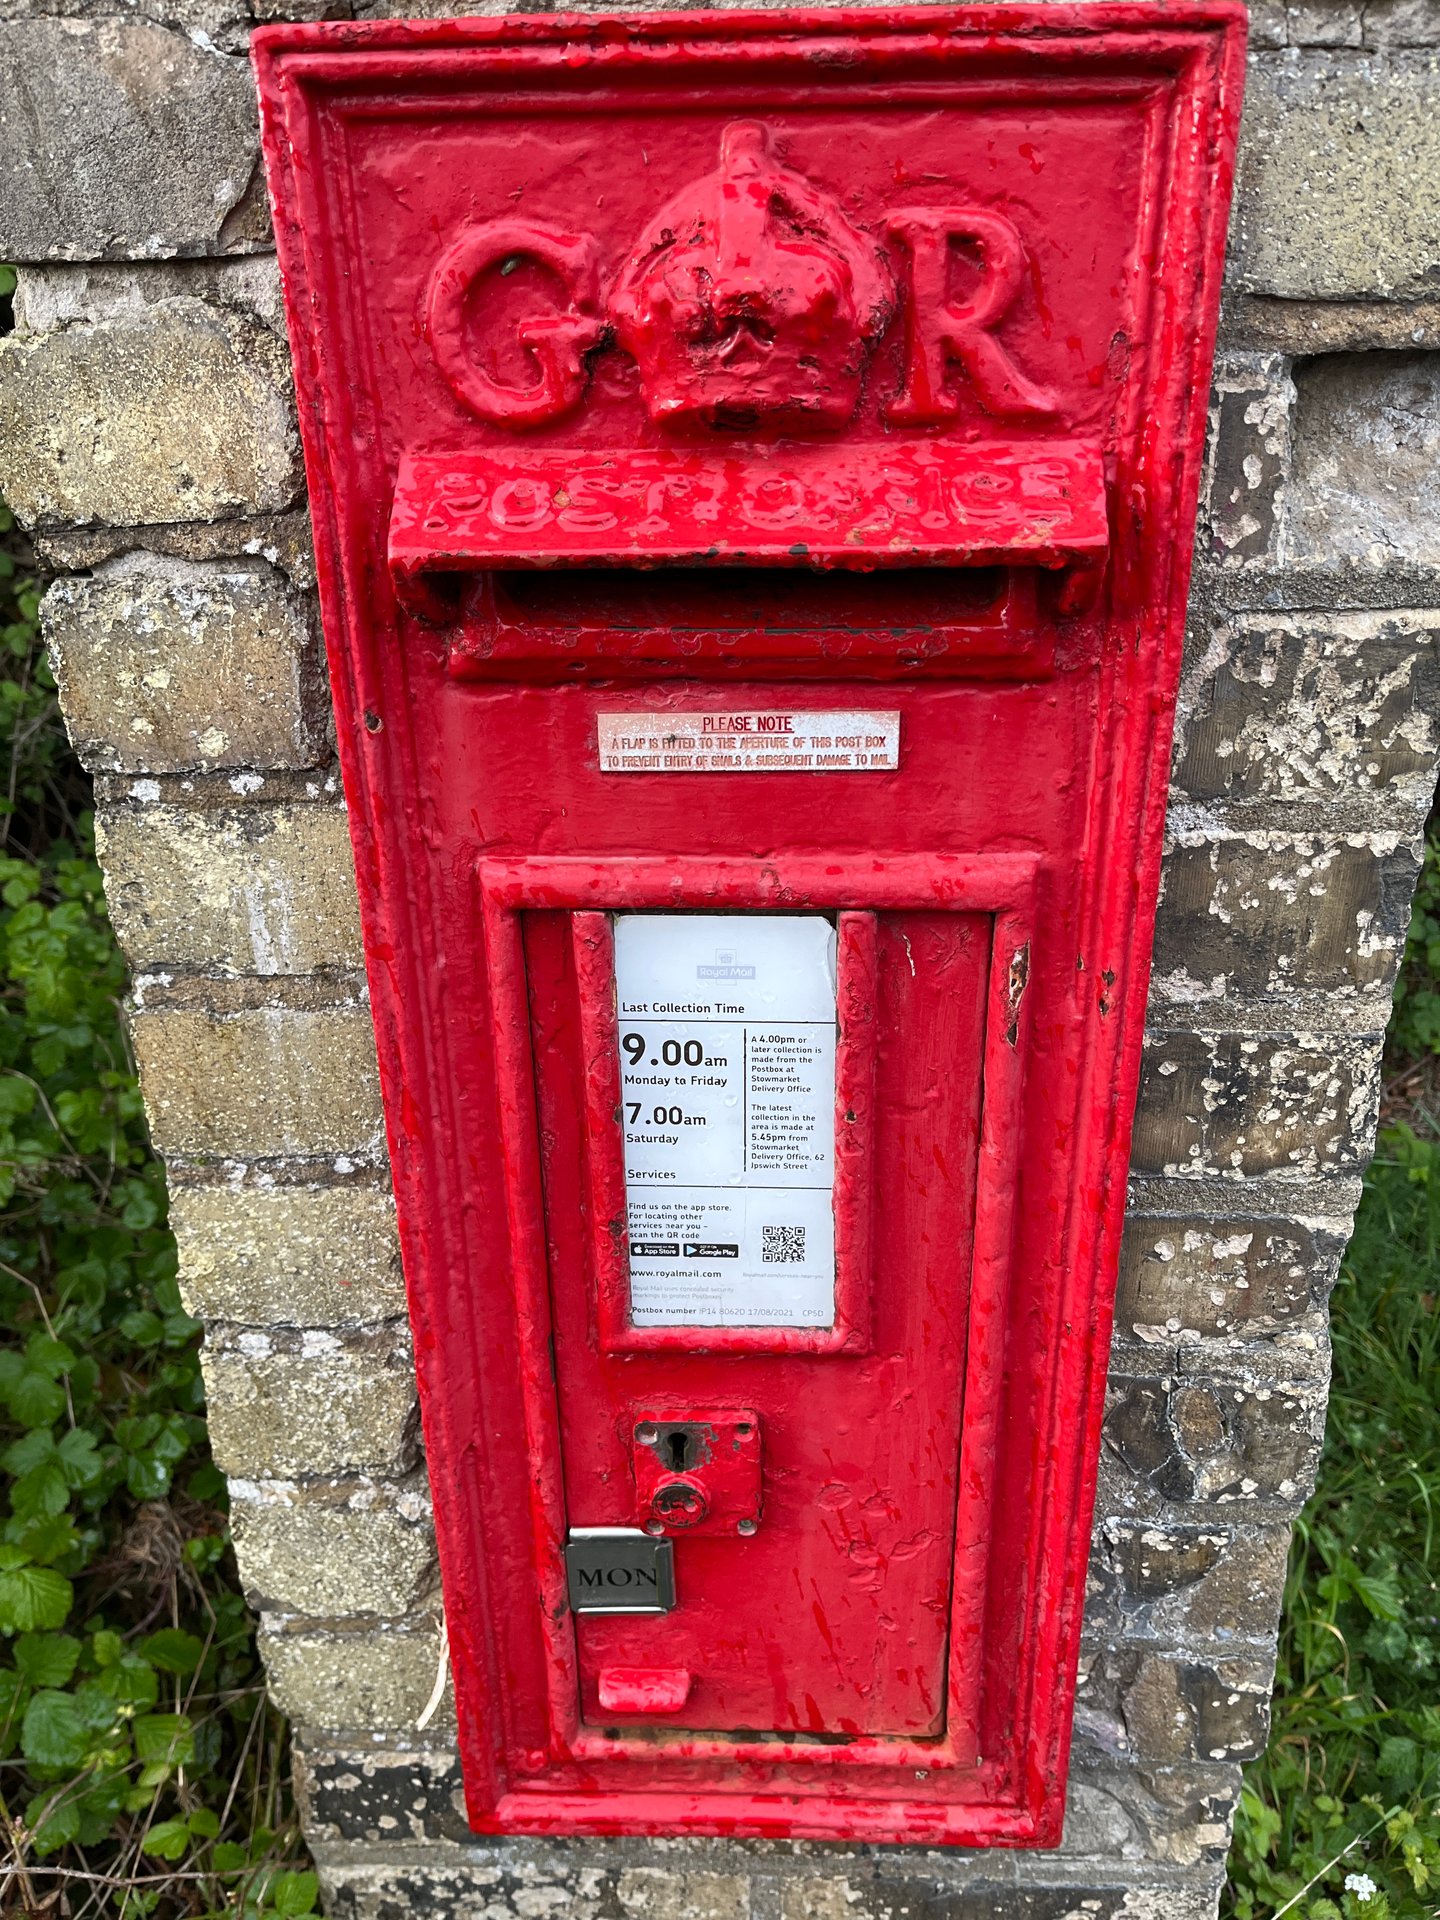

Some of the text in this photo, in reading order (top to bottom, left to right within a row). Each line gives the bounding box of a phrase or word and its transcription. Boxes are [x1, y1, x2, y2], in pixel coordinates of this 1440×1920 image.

[427, 204, 1059, 430] G R
[702, 716, 793, 732] PLEASE NOTE
[611, 735, 887, 750] A FLAP IS FITTED TO THE APERTURE OF THIS POST BOX
[606, 755, 619, 768] TO
[622, 755, 660, 768] PREVENT
[664, 755, 693, 768] ENTRY
[696, 755, 709, 768] OF
[711, 755, 742, 768] SNAILS
[756, 754, 813, 768] SUBSEQUENT
[816, 754, 852, 766] DAMAGE
[855, 753, 868, 766] TO
[870, 753, 892, 766] MAIL
[700, 967, 753, 977] Royal Mail
[622, 1002, 745, 1014] Last Collection Time
[759, 1034, 795, 1045] 4.00pm
[622, 1033, 728, 1067] 9.00am
[773, 1046, 812, 1054] collection
[751, 1065, 784, 1073] Postbox
[624, 1075, 728, 1088] Monday to Friday
[751, 1075, 801, 1083] Stowmarket
[751, 1085, 812, 1094] Delivery Office
[625, 1102, 707, 1126] 7.00am
[626, 1133, 679, 1146] Saturday
[751, 1133, 787, 1142] 5.45pm
[751, 1143, 800, 1151] Stowmarket
[751, 1153, 784, 1161] Delivery
[627, 1169, 677, 1179] Services
[690, 1204, 706, 1212] app
[645, 1213, 678, 1221] locating
[680, 1213, 703, 1221] other
[666, 1232, 679, 1240] QR
[630, 1270, 722, 1278] www.royalmail.com
[577, 1568, 660, 1587] MON
